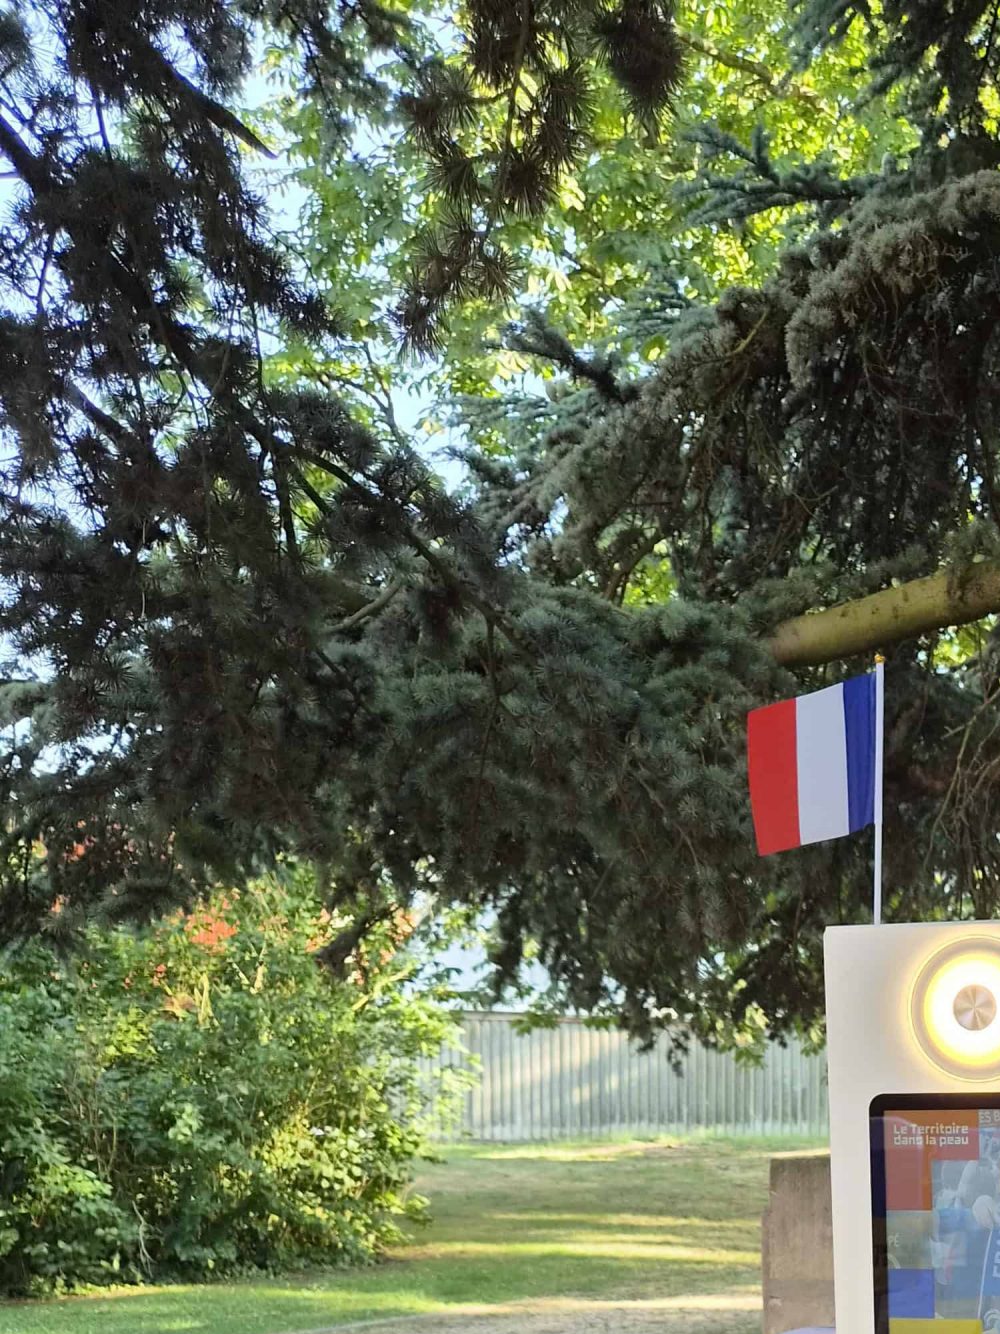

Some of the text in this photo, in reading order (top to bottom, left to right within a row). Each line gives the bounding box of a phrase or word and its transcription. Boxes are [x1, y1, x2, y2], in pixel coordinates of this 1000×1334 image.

[893, 1122, 969, 1135] Le Territoire
[893, 1134, 969, 1147] dans la peau
